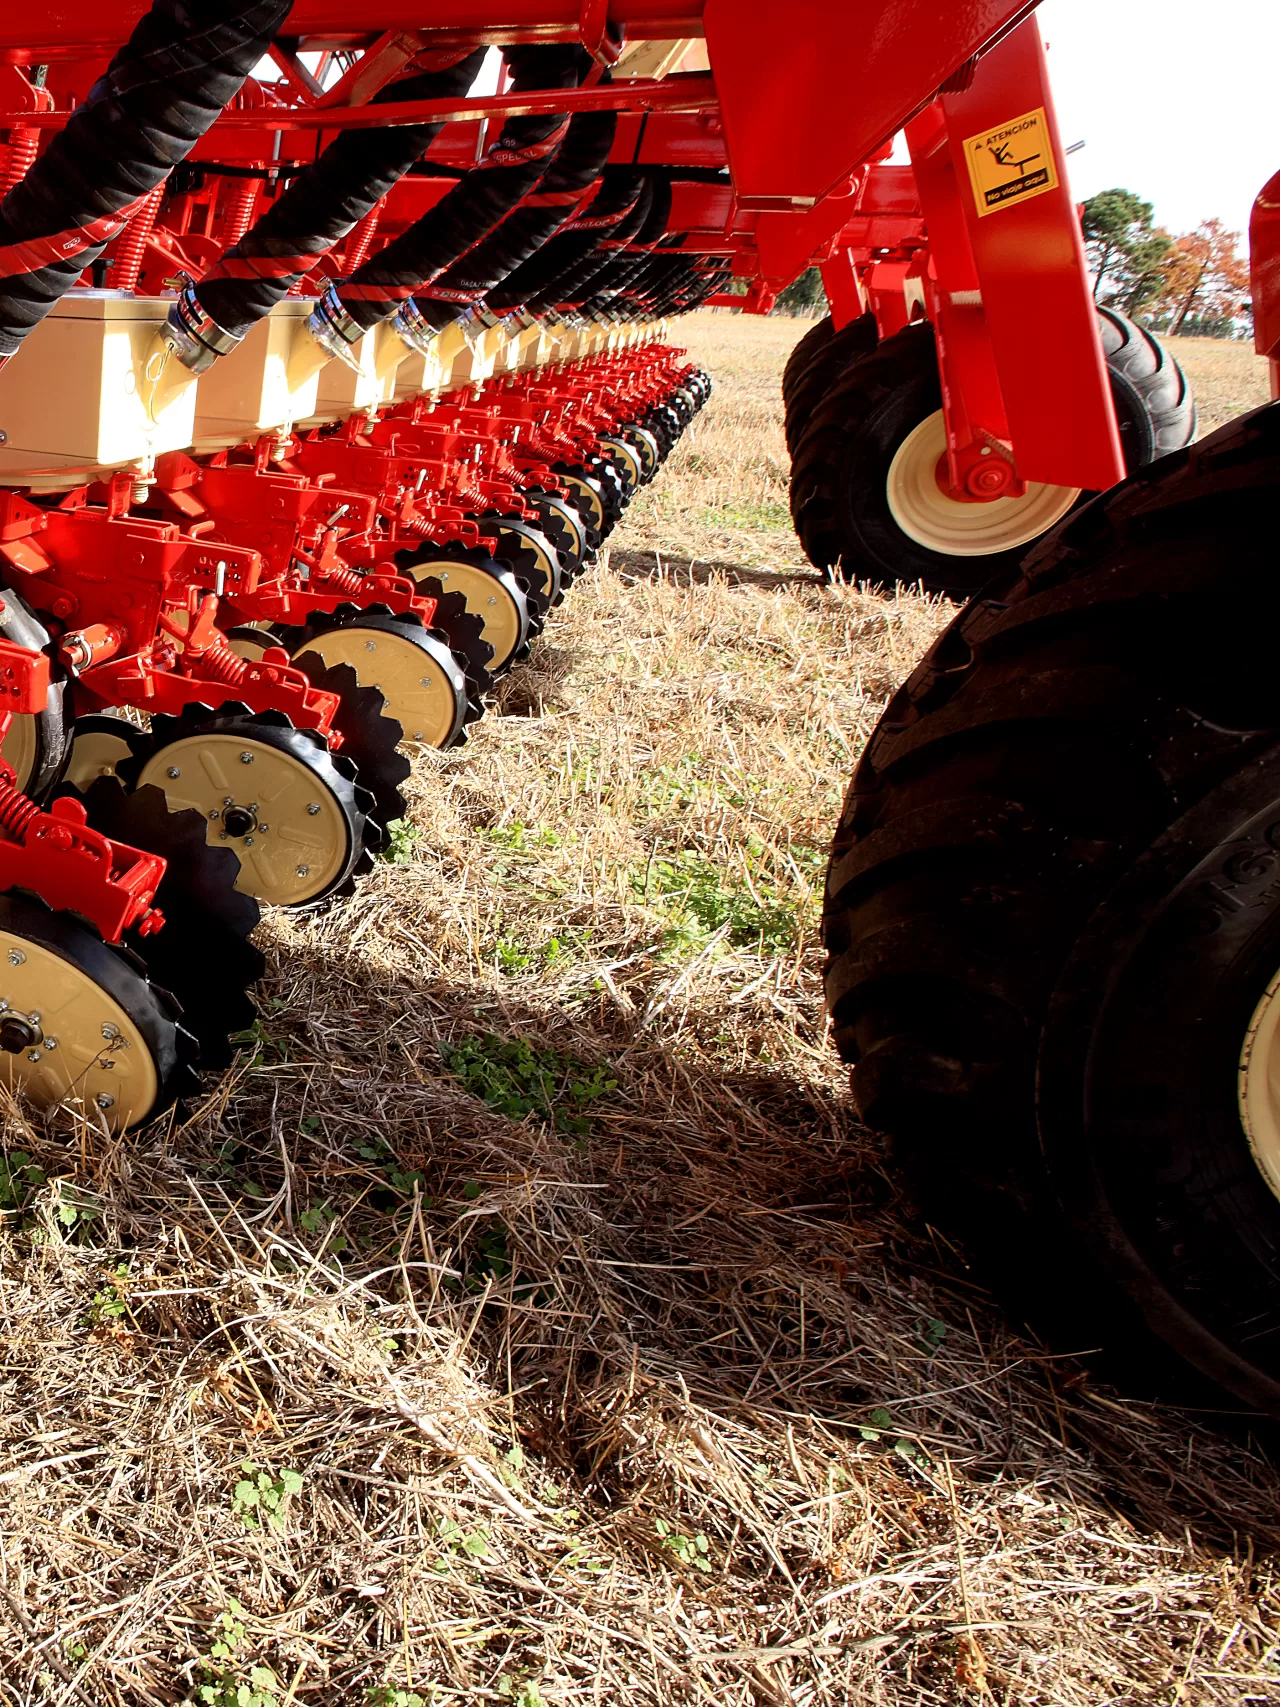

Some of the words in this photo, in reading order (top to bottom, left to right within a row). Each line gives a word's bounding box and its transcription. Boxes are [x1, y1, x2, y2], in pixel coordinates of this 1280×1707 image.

[986, 118, 1037, 145] ATENCIÓN
[987, 192, 1000, 202] No
[1002, 183, 1023, 196] viaje
[1024, 172, 1046, 187] aquí
[568, 218, 611, 230] DUNLOP
